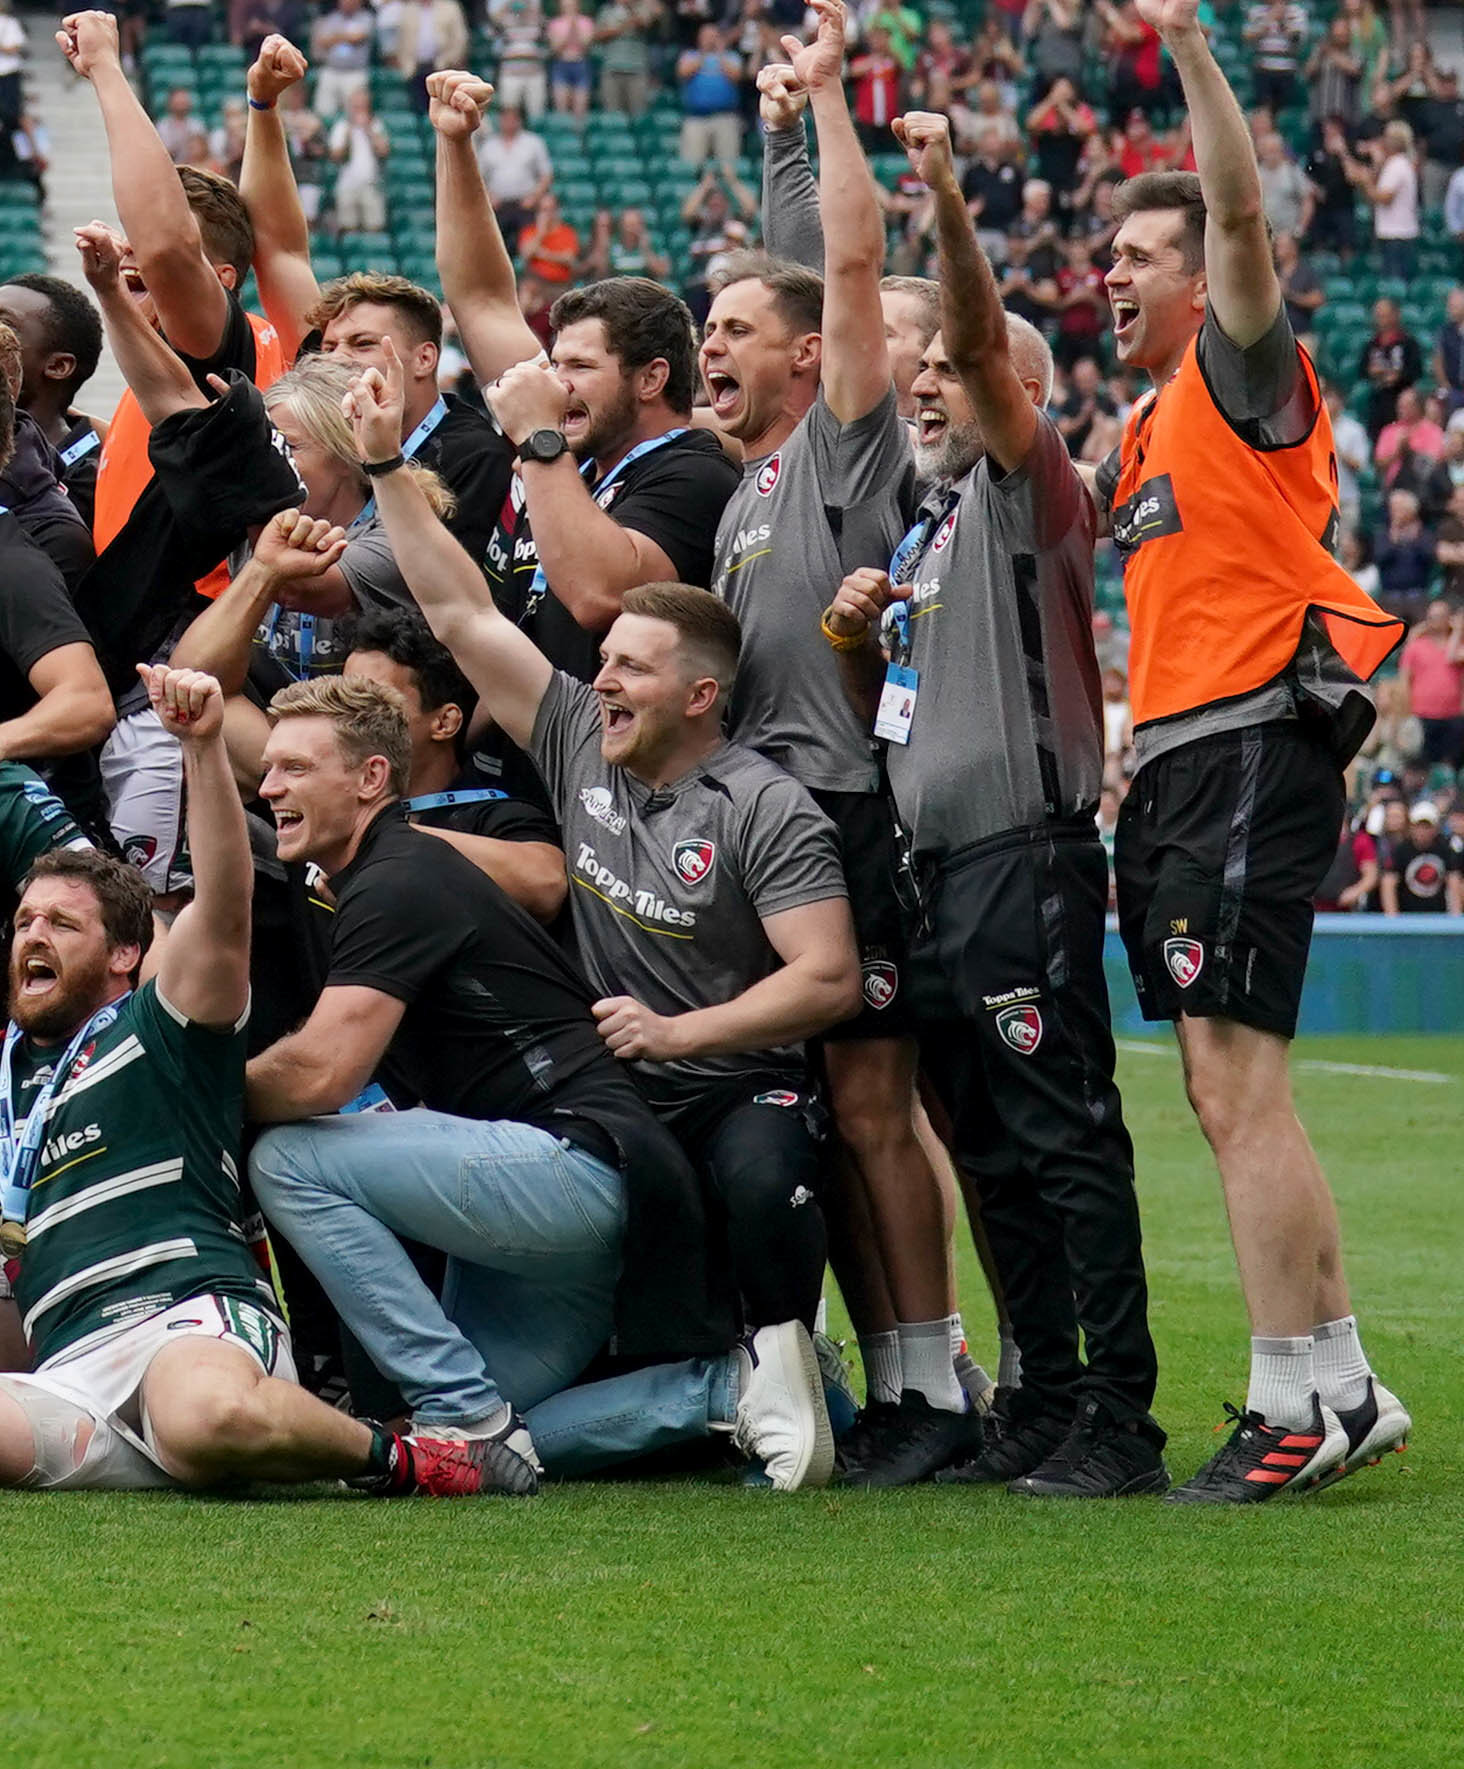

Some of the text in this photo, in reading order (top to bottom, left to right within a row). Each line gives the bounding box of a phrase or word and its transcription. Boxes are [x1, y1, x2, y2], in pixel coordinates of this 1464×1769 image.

[578, 843, 696, 928] Topp Tiles
[1170, 918, 1188, 936] SW
[983, 990, 1016, 1006] Topps
[39, 1121, 103, 1166] Tiles
